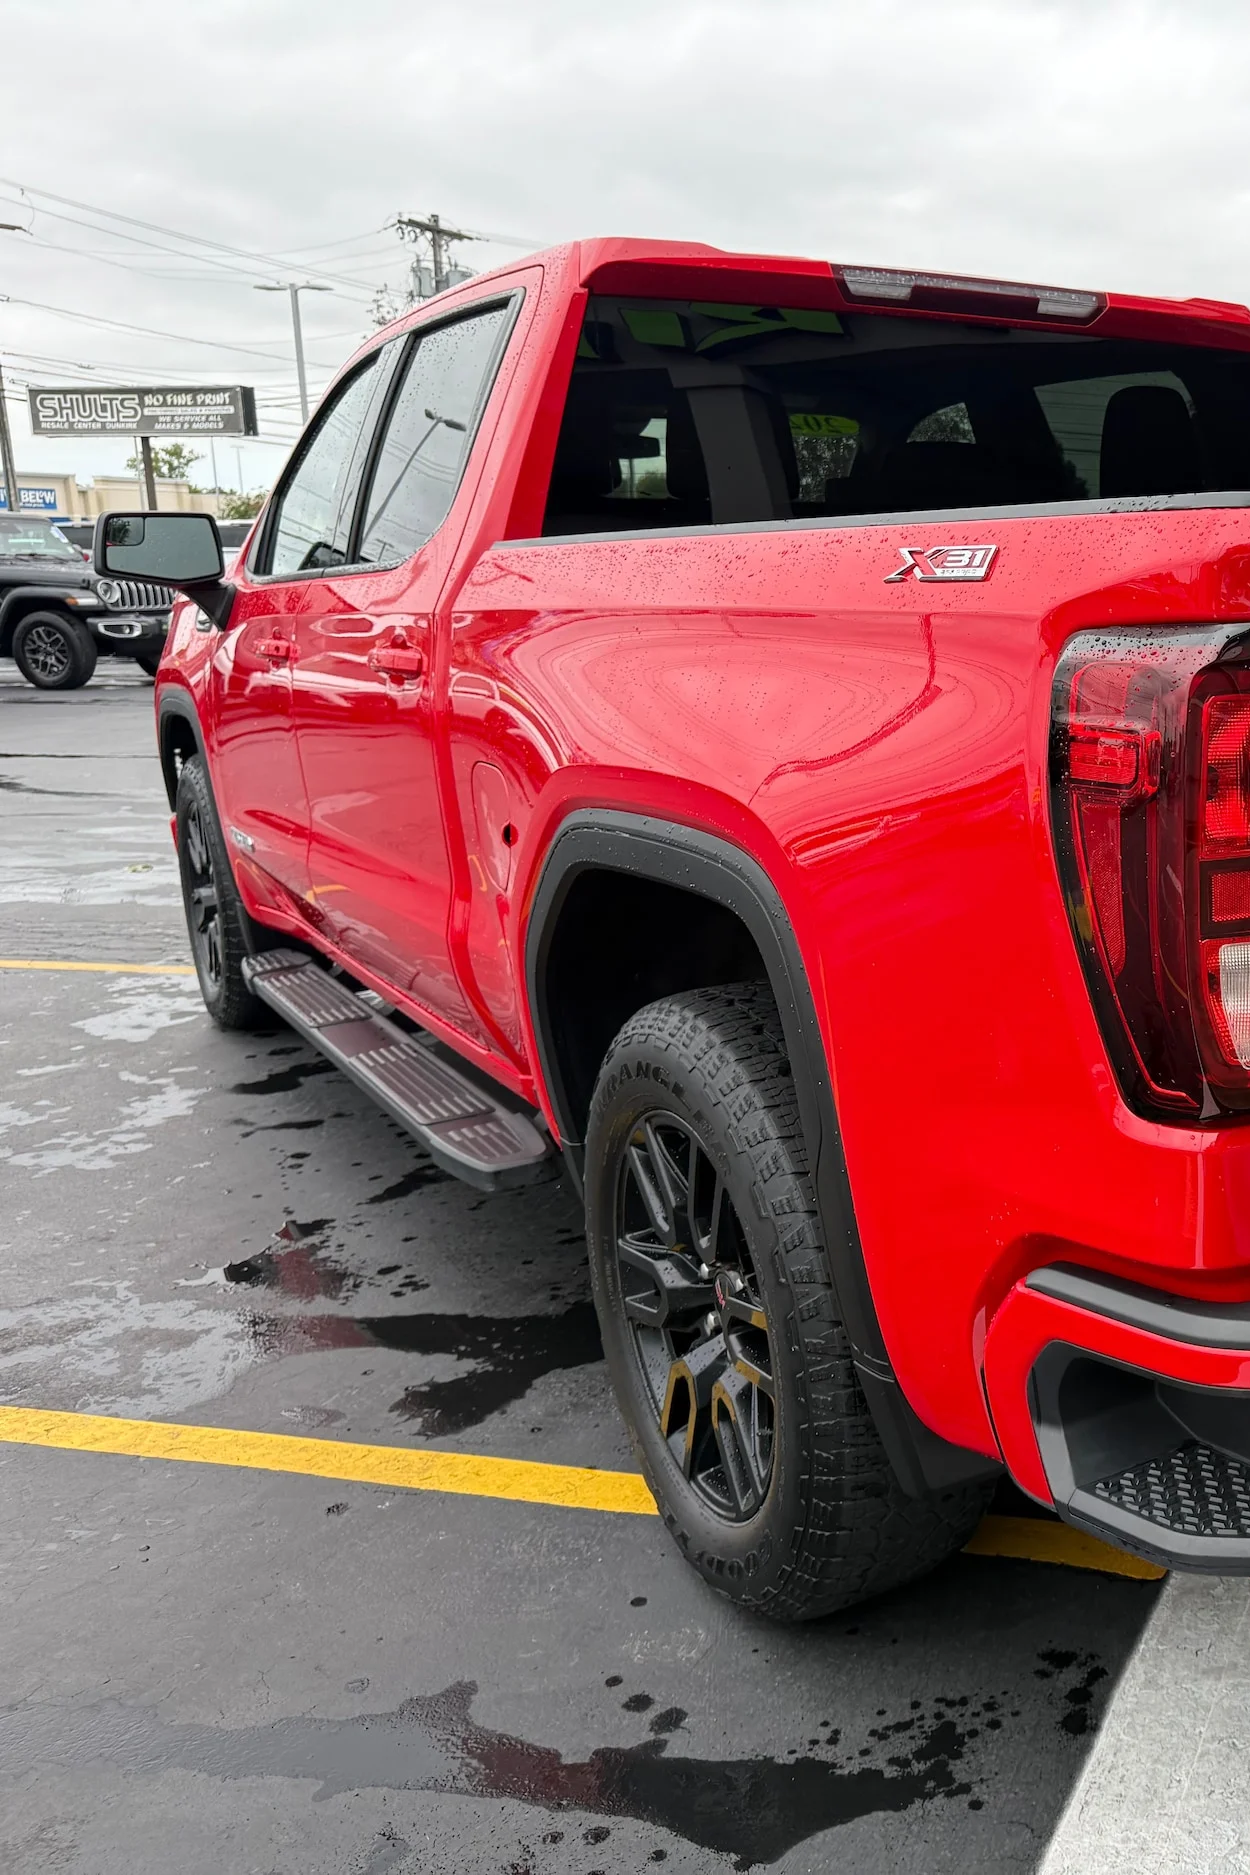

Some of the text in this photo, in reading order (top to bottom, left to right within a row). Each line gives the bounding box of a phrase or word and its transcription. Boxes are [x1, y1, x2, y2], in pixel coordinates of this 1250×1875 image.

[143, 392, 230, 406] NO FINE PRINT
[36, 393, 142, 422] SHULTS
[41, 421, 138, 430] RESALE CENTER DUNKIRK
[154, 422, 181, 430] MAKES
[191, 421, 224, 430] MODELS
[158, 415, 172, 423] WE
[208, 414, 222, 422] ALL
[20, 490, 55, 504] BELOW
[883, 544, 998, 583] X31
